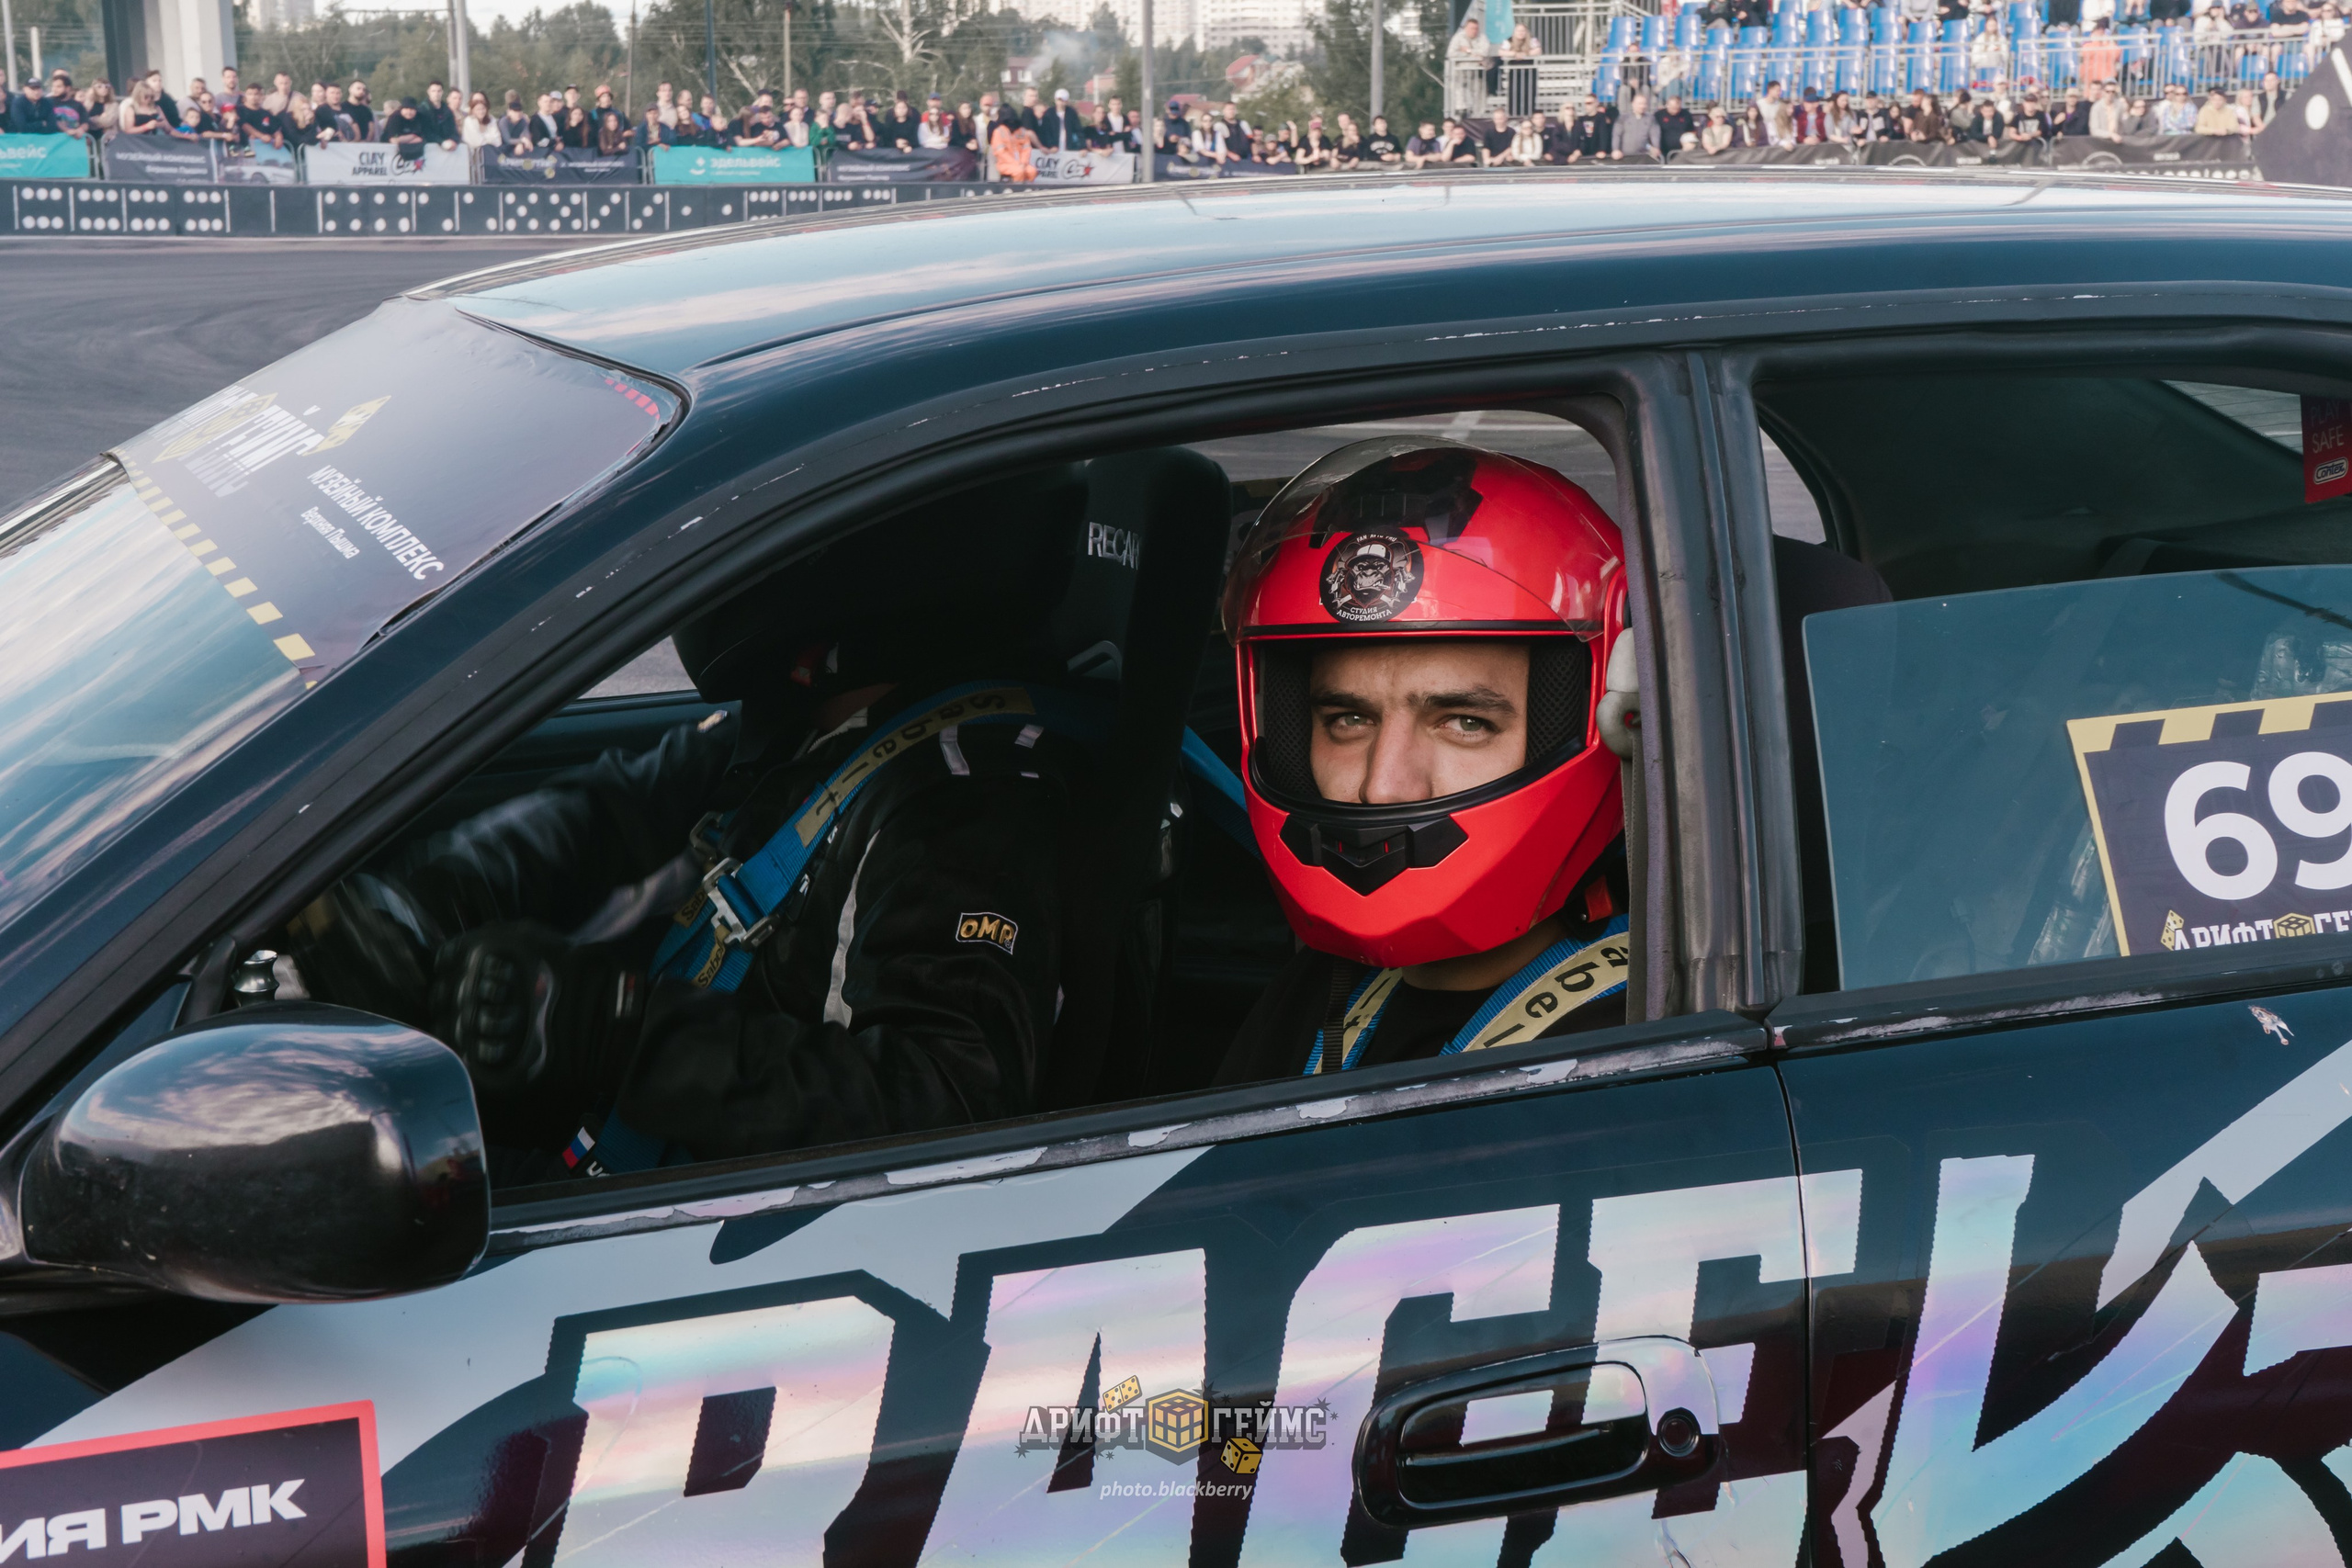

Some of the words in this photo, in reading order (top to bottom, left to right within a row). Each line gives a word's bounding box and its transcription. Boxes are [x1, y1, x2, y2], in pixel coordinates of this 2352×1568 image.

[0, 143, 47, 159] ьвейс
[359, 152, 385, 164] CLAY
[352, 166, 388, 176] APPAREL
[2312, 424, 2346, 454] SAFE
[300, 506, 336, 536] Верхняя
[325, 527, 360, 559] Пышма
[307, 464, 384, 518] МУЗЕЙНЫЙ
[356, 506, 445, 581] КОМПЛЕКС
[1087, 521, 1139, 570] RECAR
[1336, 609, 1393, 622] АВТОРЕМОНТА
[1350, 606, 1378, 615] СТУДИЯ
[681, 890, 707, 920] Sab
[959, 916, 1014, 944] OMP
[697, 939, 726, 987] Sabel
[1483, 946, 1629, 1048] abel
[0, 1507, 107, 1562] ИЯ
[120, 1477, 308, 1545] РМК
